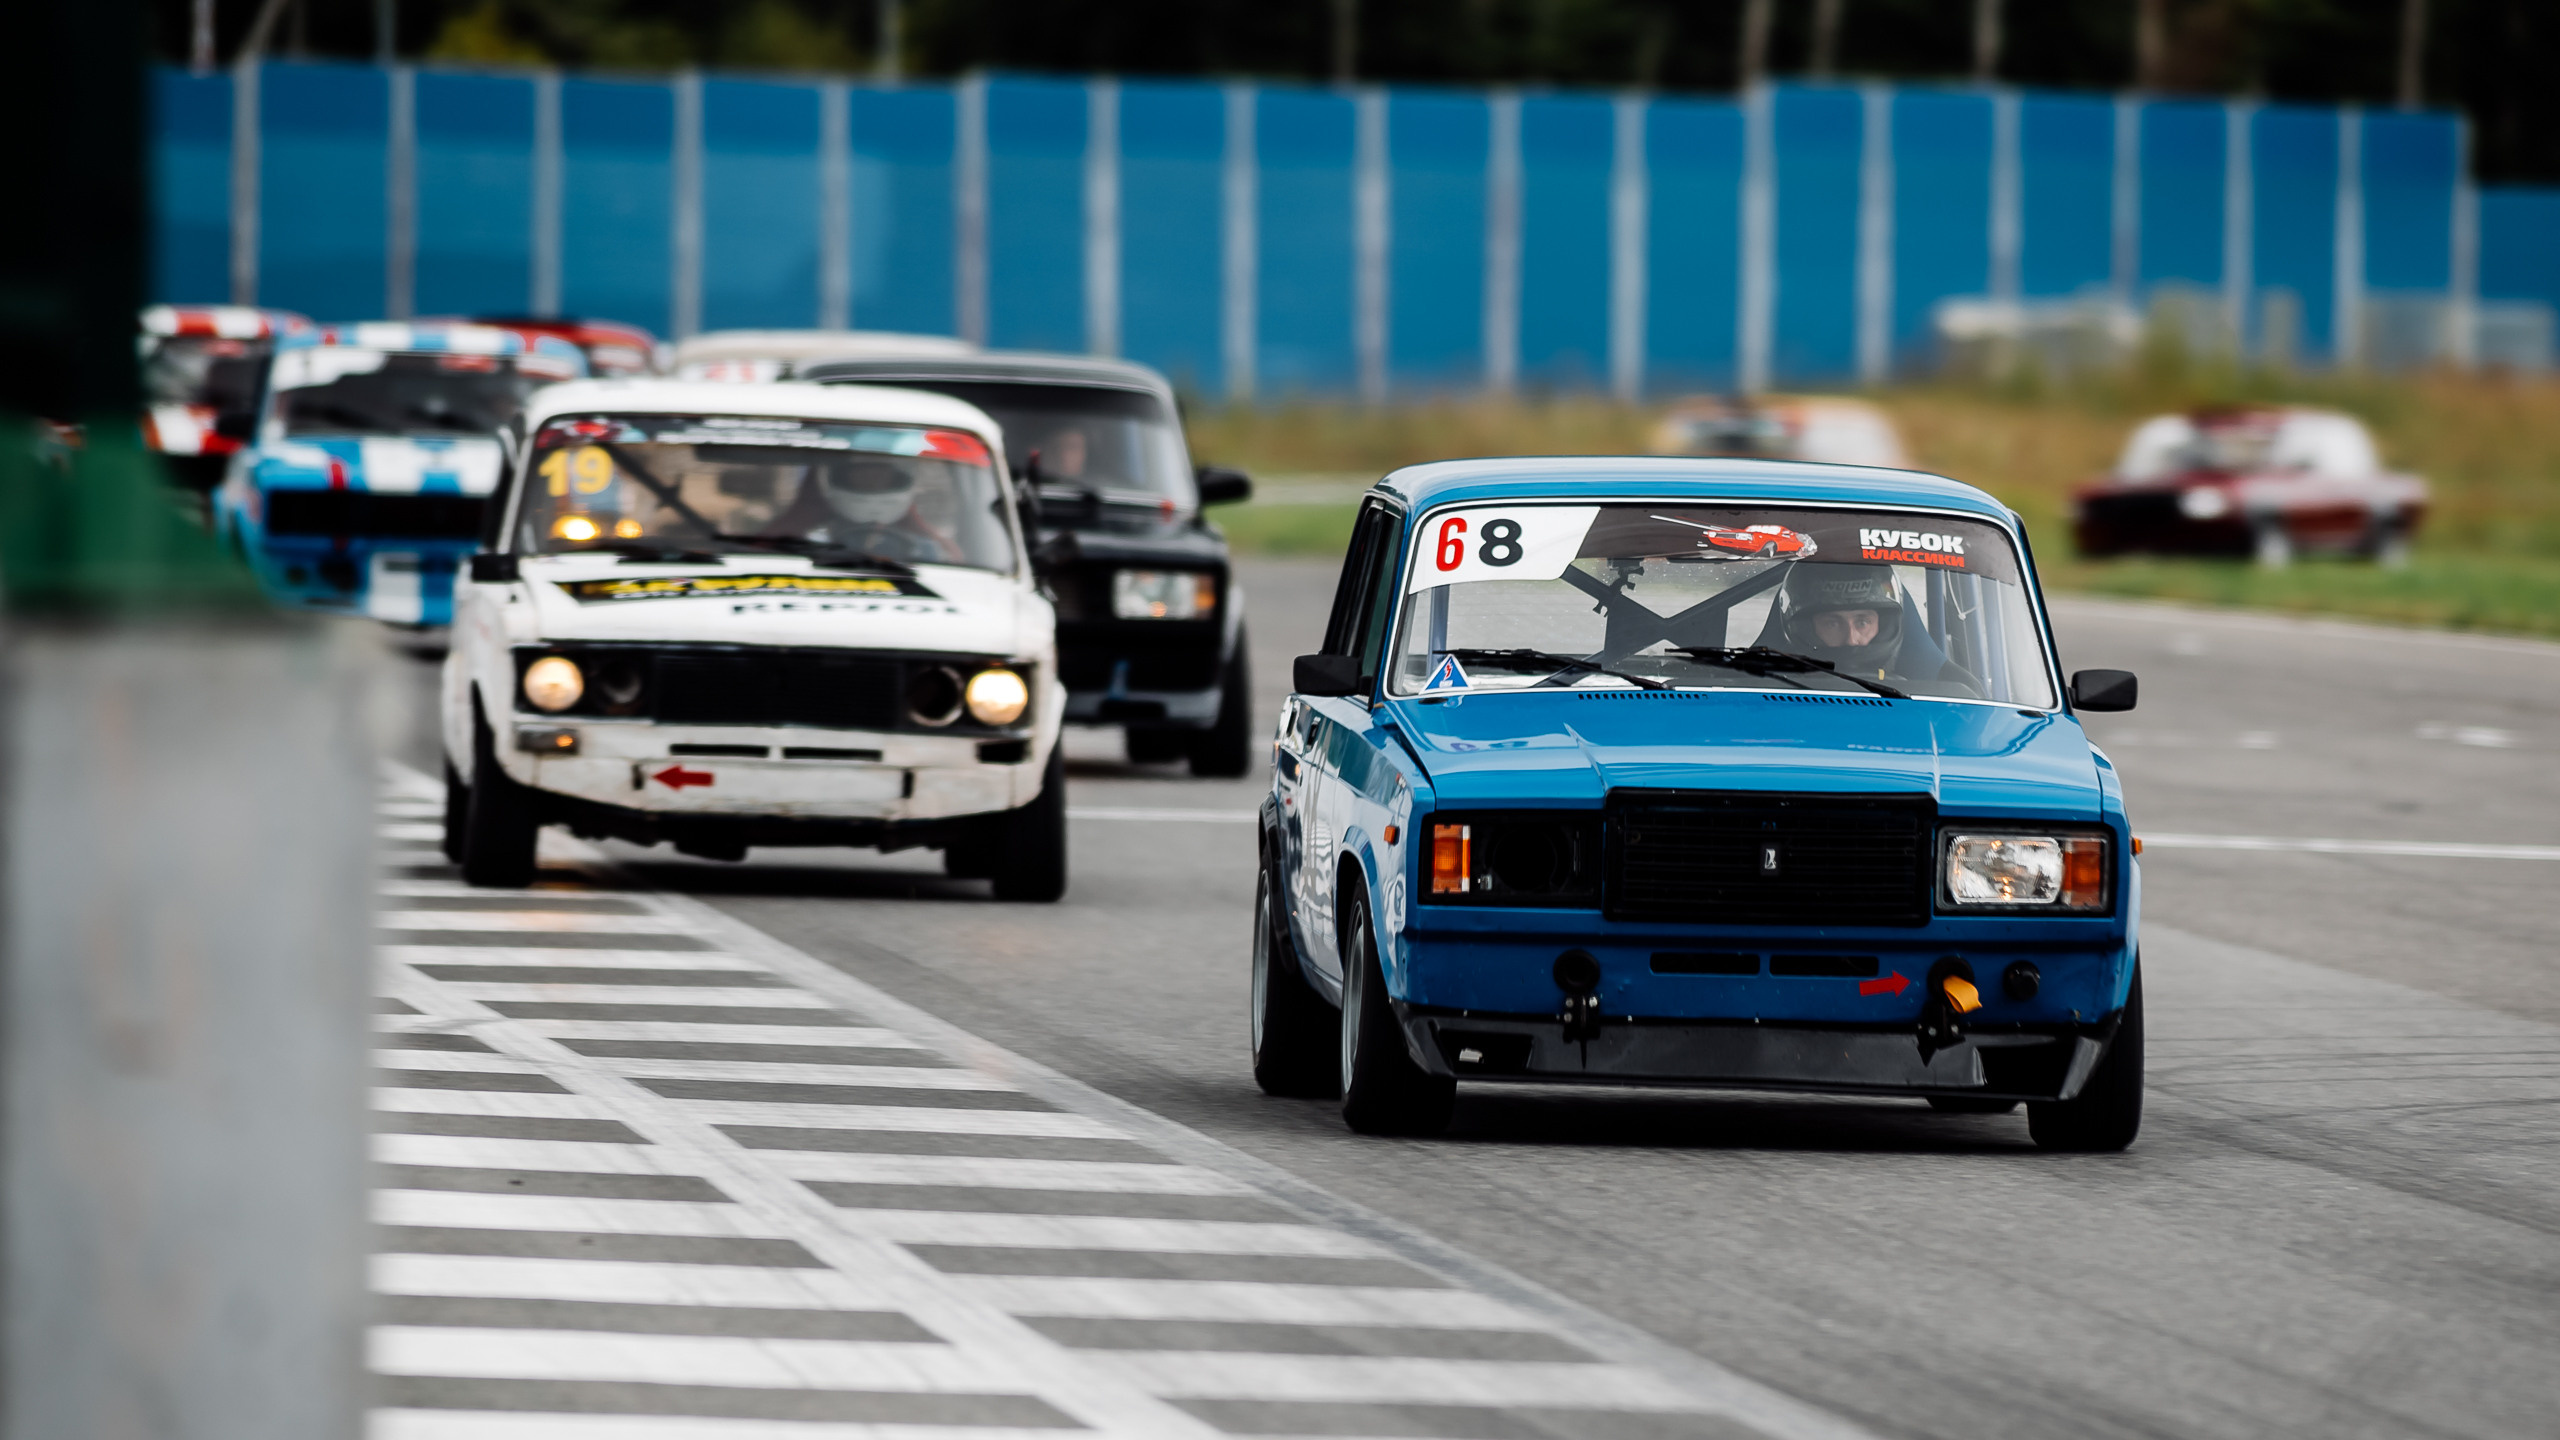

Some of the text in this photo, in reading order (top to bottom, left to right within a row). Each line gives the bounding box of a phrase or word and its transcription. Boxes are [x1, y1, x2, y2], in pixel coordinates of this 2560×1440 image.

[538, 445, 615, 497] 19
[1859, 528, 1965, 554] КУБОК
[1862, 548, 1965, 568] КЛАССИКИ
[1825, 579, 1872, 594] NOLAN
